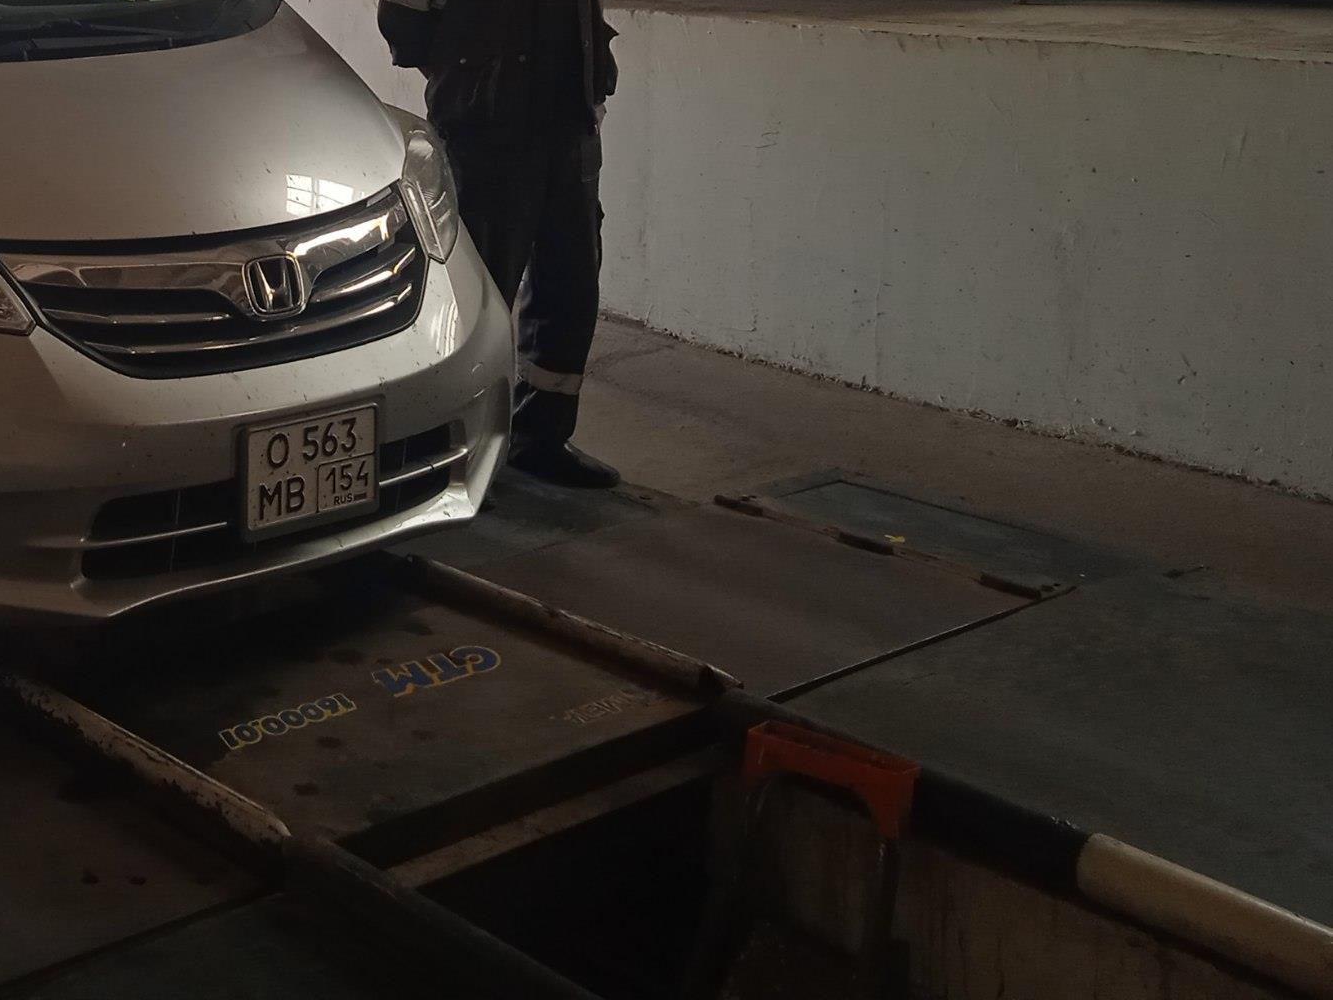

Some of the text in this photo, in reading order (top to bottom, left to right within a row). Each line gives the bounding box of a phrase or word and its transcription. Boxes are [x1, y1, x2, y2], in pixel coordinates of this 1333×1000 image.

[302, 417, 357, 462] 563
[326, 461, 369, 494] 154
[258, 475, 305, 520] МВ
[333, 493, 353, 505] RUS
